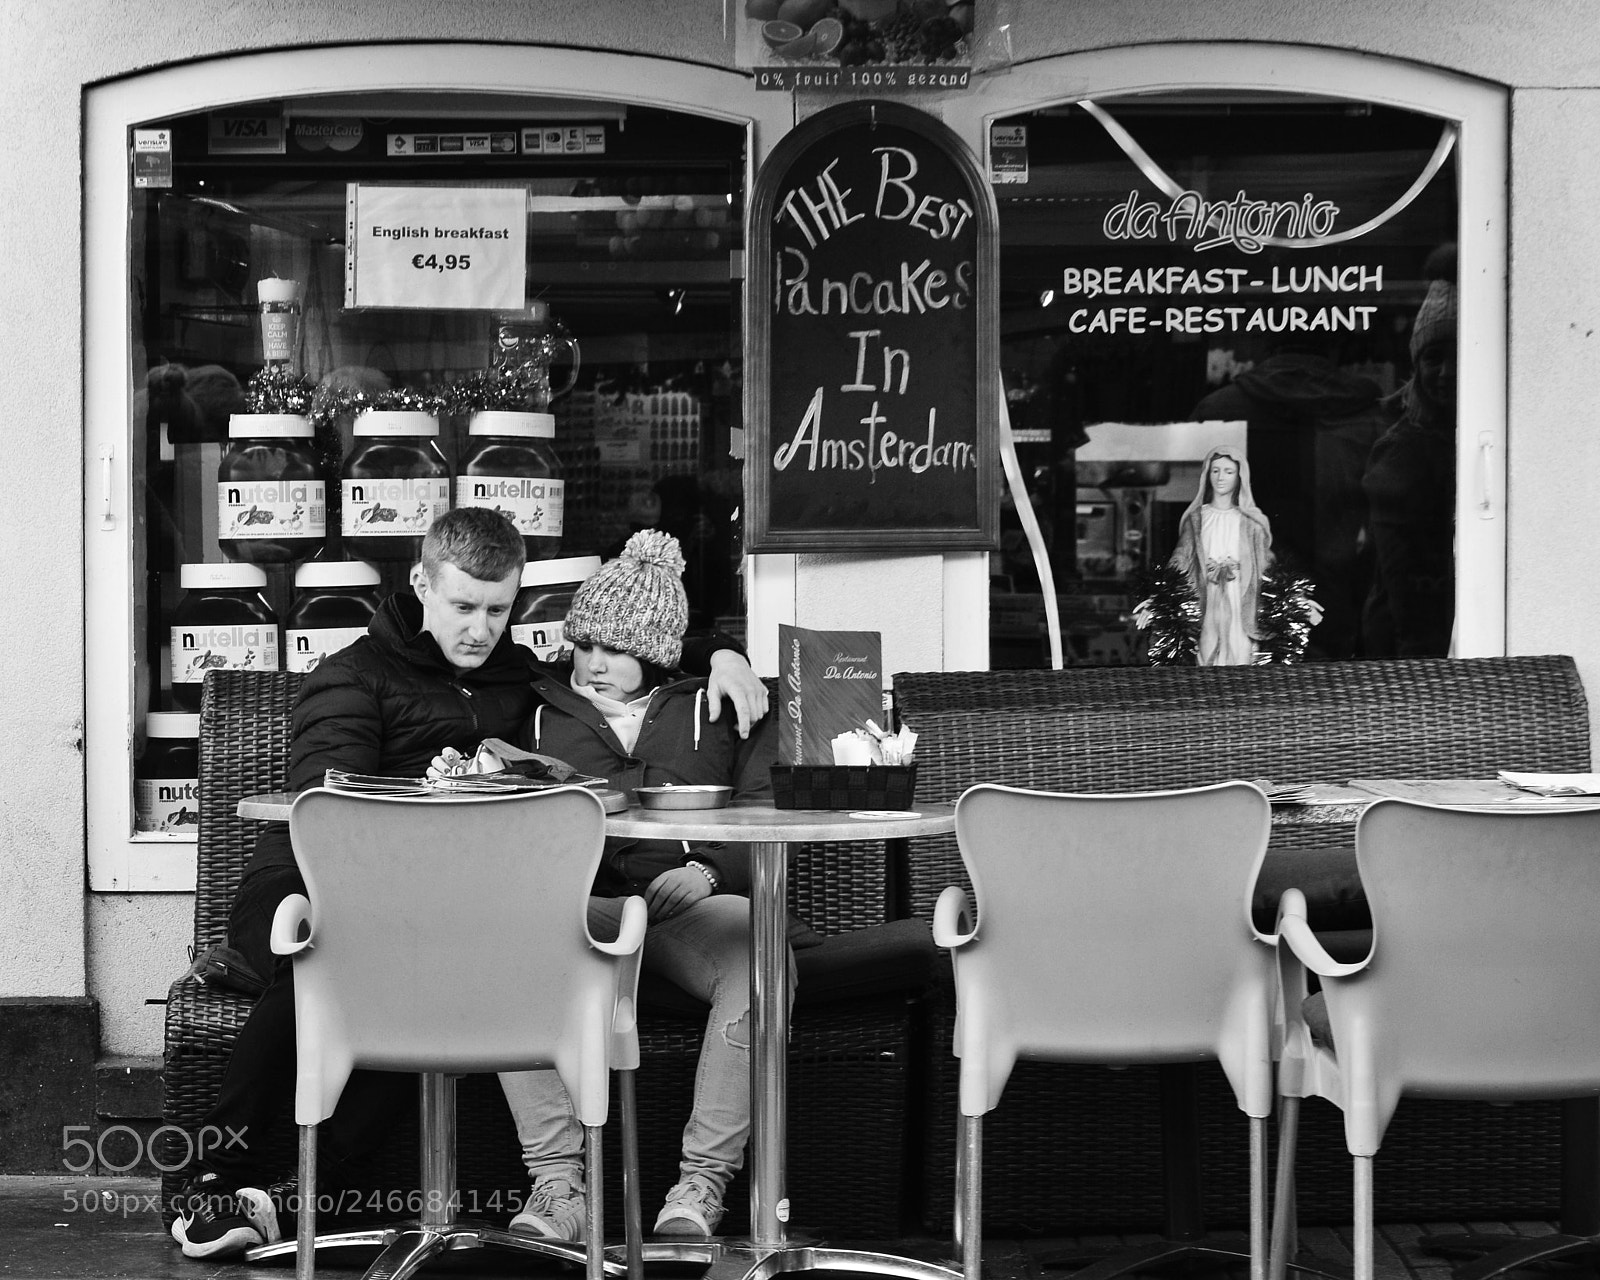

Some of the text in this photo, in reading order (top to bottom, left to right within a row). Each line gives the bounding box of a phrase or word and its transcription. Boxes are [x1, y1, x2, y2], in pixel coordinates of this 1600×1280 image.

[795, 72, 840, 86] fruit
[851, 71, 896, 86] 100%
[907, 71, 969, 86] gezond
[222, 119, 269, 137] VISA
[294, 123, 362, 137] MasterCard
[774, 157, 865, 250] THE
[1103, 189, 1341, 254] da Antonio
[372, 226, 510, 242] English breakfast
[411, 254, 472, 273] €4,95
[1068, 306, 1379, 335] CAFE-RESTAURANT
[267, 331, 288, 339] CALM
[268, 342, 287, 350] HAVE
[840, 329, 911, 395] In
[773, 386, 978, 484] Amsterdam
[228, 481, 307, 504] nutella
[352, 479, 431, 501] nutella
[474, 480, 546, 499] nutella
[182, 627, 260, 648] nutella
[823, 665, 878, 680] Da Antonio
[159, 783, 199, 800] nute
